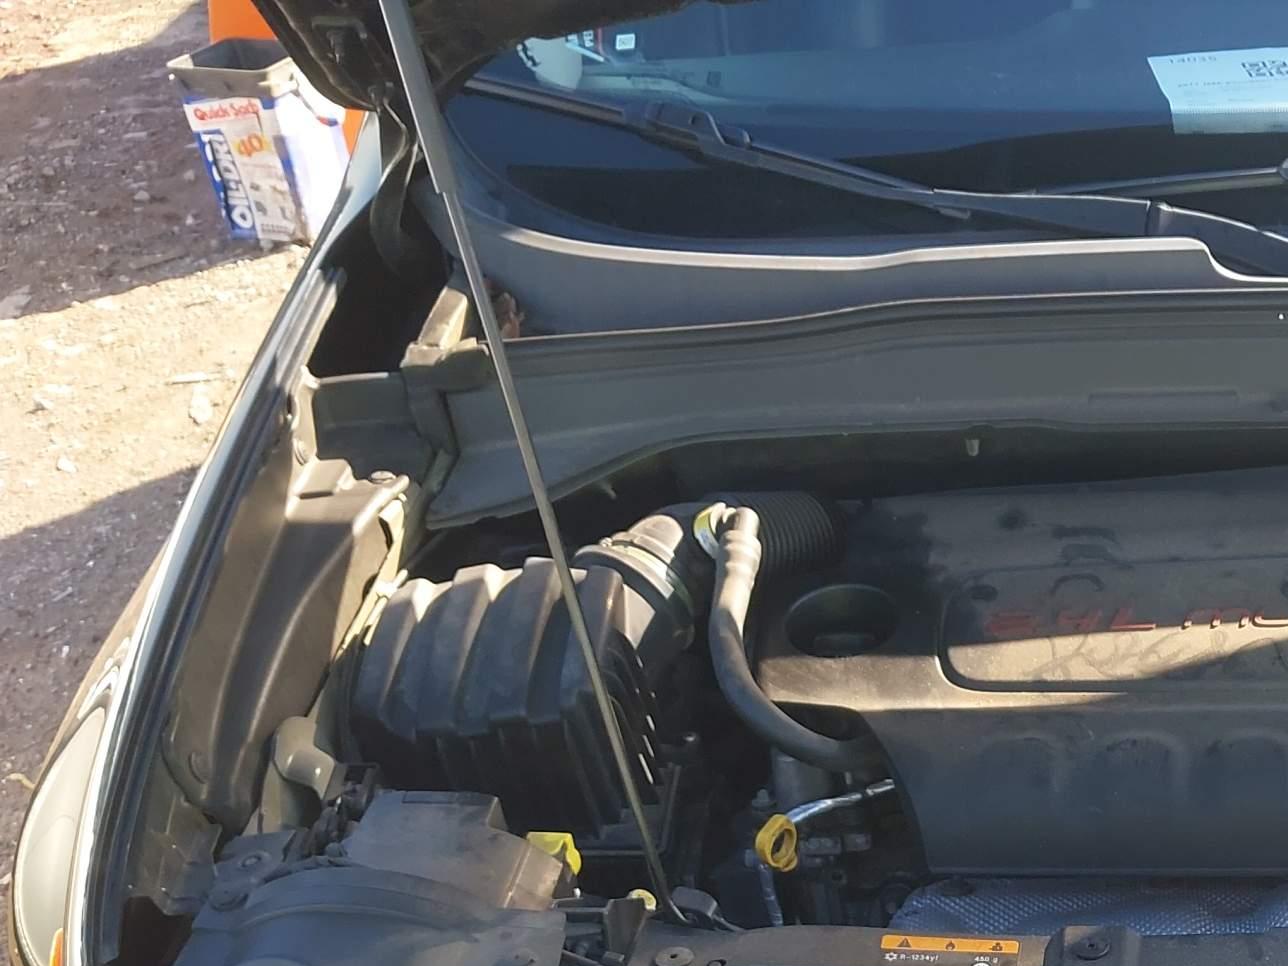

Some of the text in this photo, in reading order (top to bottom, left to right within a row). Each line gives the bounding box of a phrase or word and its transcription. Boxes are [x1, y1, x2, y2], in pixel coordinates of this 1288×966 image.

[193, 104, 230, 121] Quick
[238, 133, 263, 158] 40
[900, 953, 939, 963] R-1234yf
